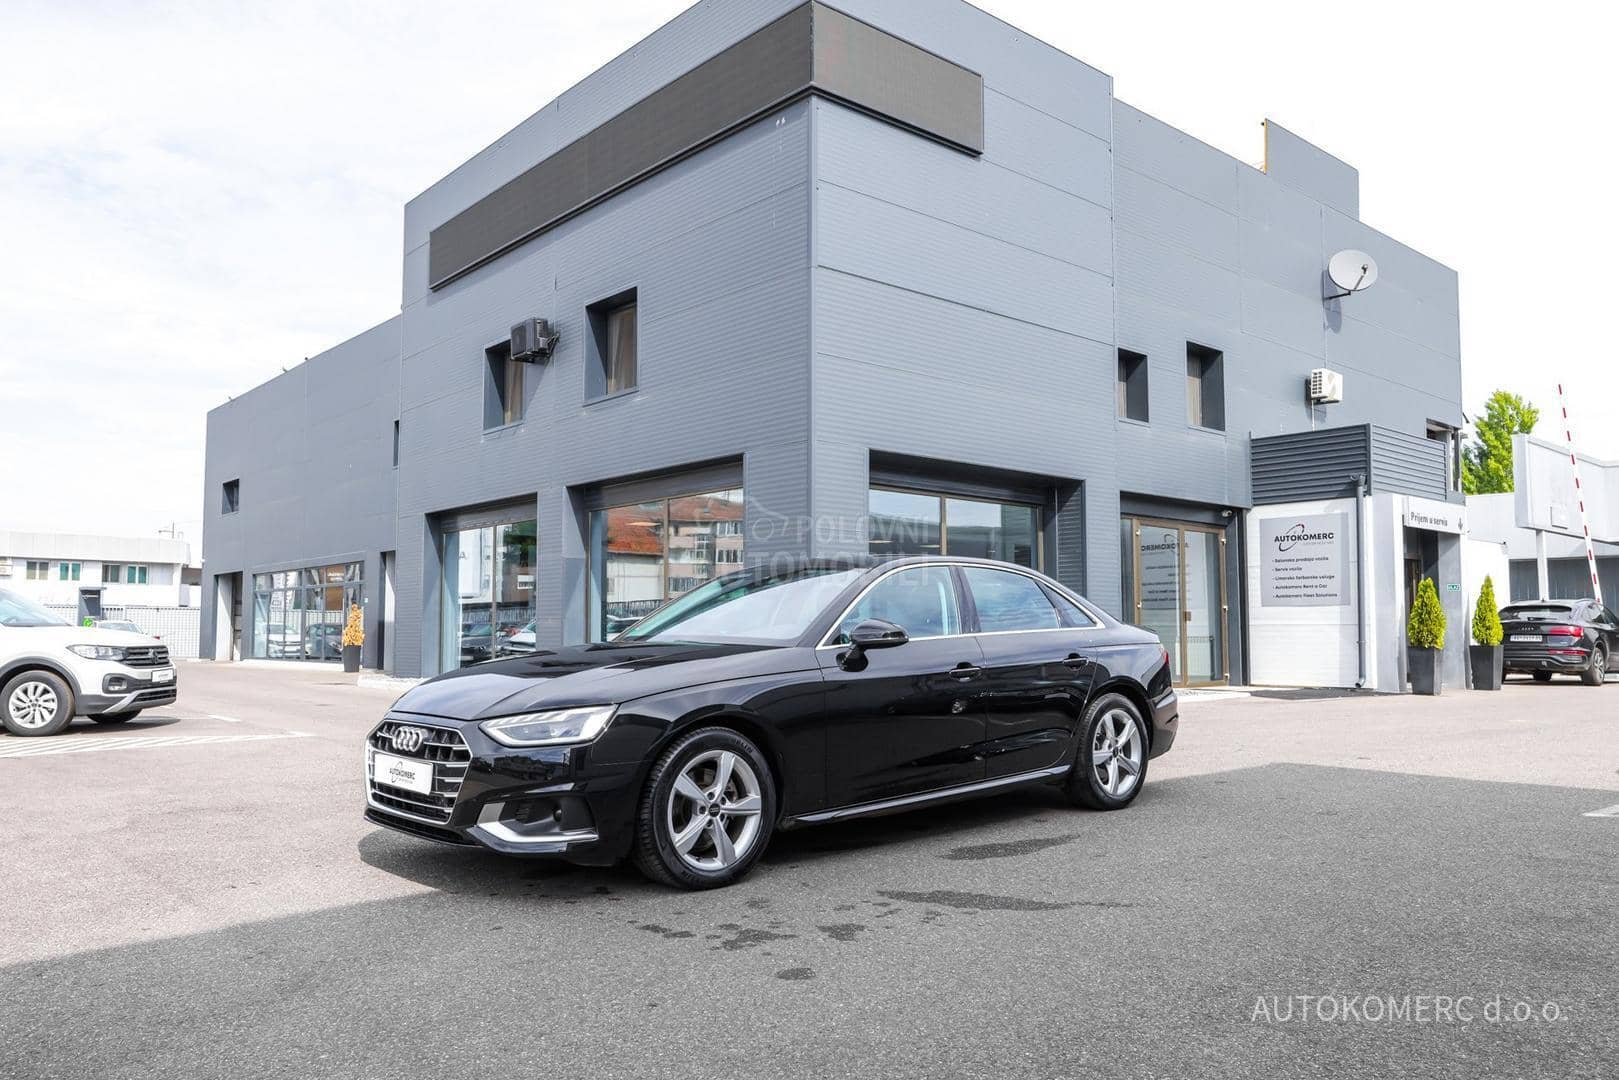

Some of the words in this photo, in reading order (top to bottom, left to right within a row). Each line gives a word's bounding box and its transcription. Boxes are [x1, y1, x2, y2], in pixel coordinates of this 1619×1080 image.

[1411, 511, 1428, 525] Prijem
[1434, 516, 1448, 527] servis
[1274, 532, 1334, 543] AUTOKOMERC
